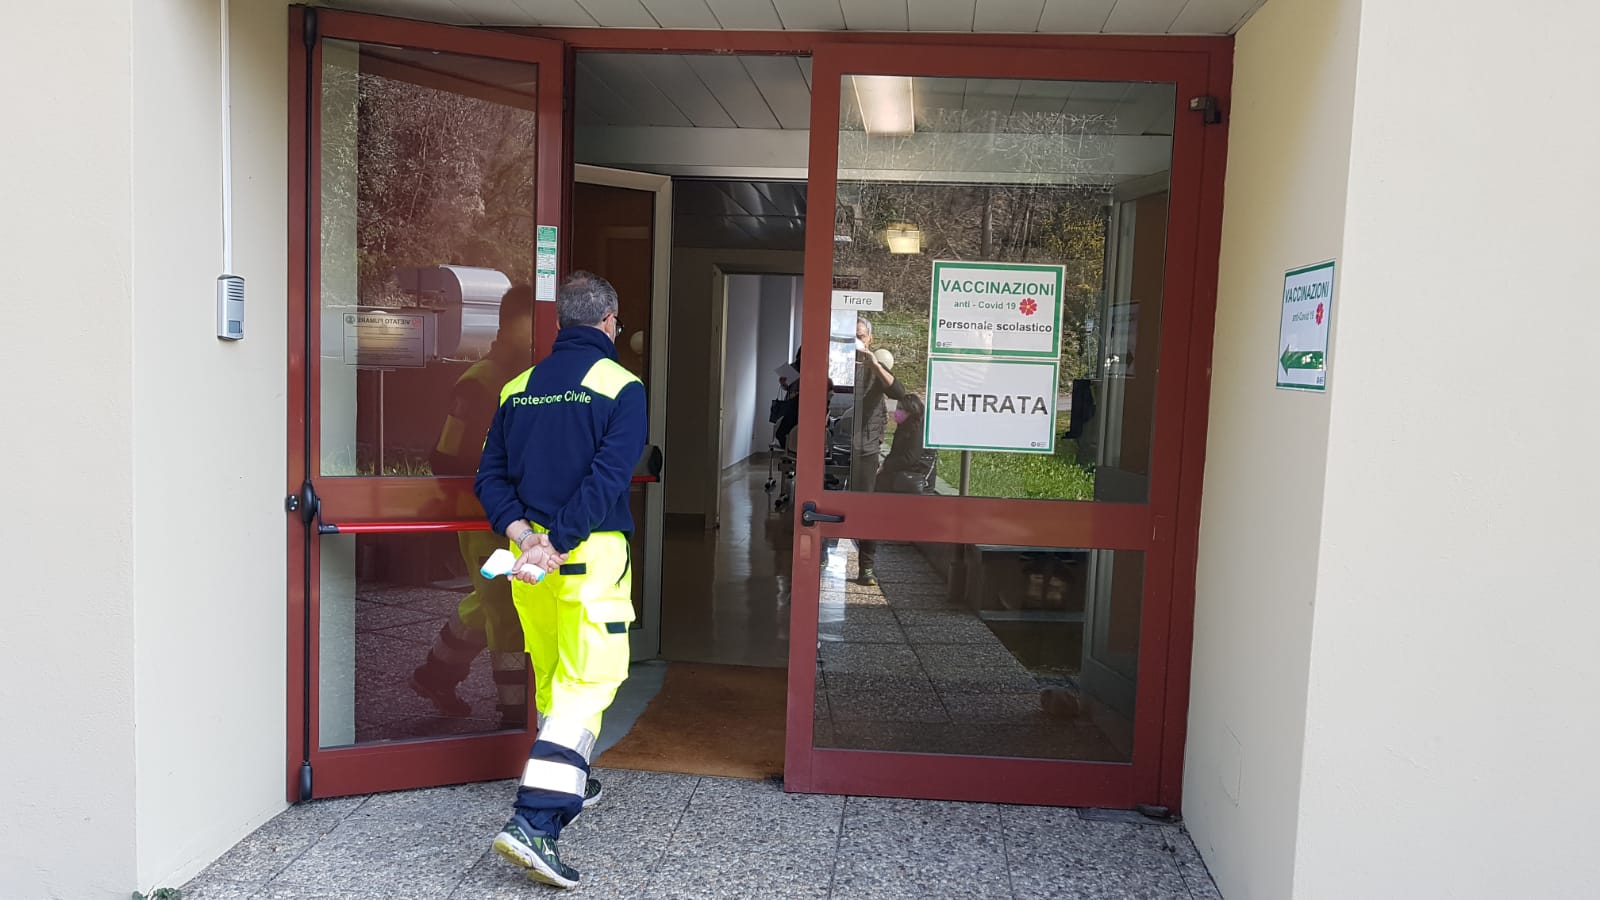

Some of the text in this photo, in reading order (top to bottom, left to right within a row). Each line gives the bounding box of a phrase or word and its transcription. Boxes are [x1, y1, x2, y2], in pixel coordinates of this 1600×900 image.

[940, 279, 1055, 296] VACCINAZIONI
[1285, 281, 1330, 304] VACCINAZIONI
[842, 294, 873, 306] Tirare
[954, 300, 971, 308] anti
[978, 300, 1004, 310] Covid
[1006, 302, 1016, 310] 19
[939, 319, 1053, 333] Personale scolastico
[564, 390, 592, 404] Civile
[934, 392, 1049, 415] ENTRATA
